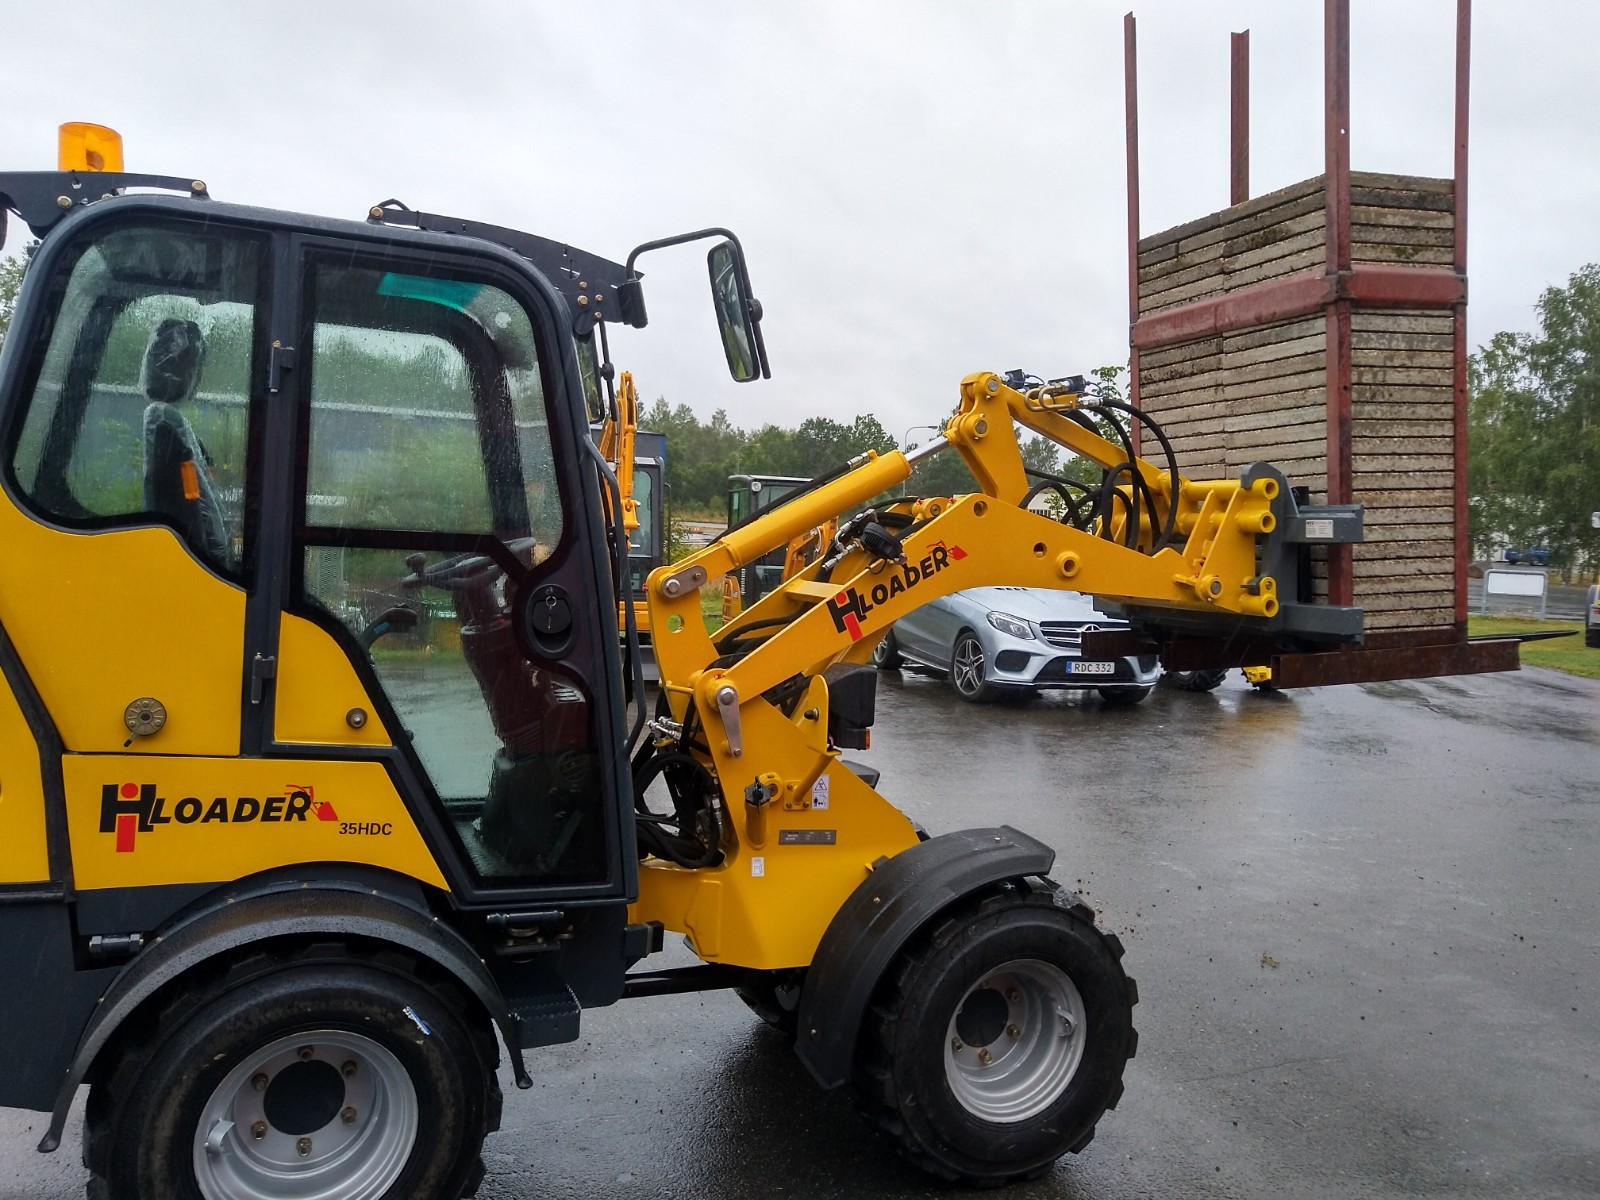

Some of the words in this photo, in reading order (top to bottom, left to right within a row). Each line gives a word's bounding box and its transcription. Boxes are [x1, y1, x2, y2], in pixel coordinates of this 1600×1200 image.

[1074, 663, 1093, 673] RDC
[1095, 663, 1112, 673] 332
[338, 822, 393, 836] 35HDC
